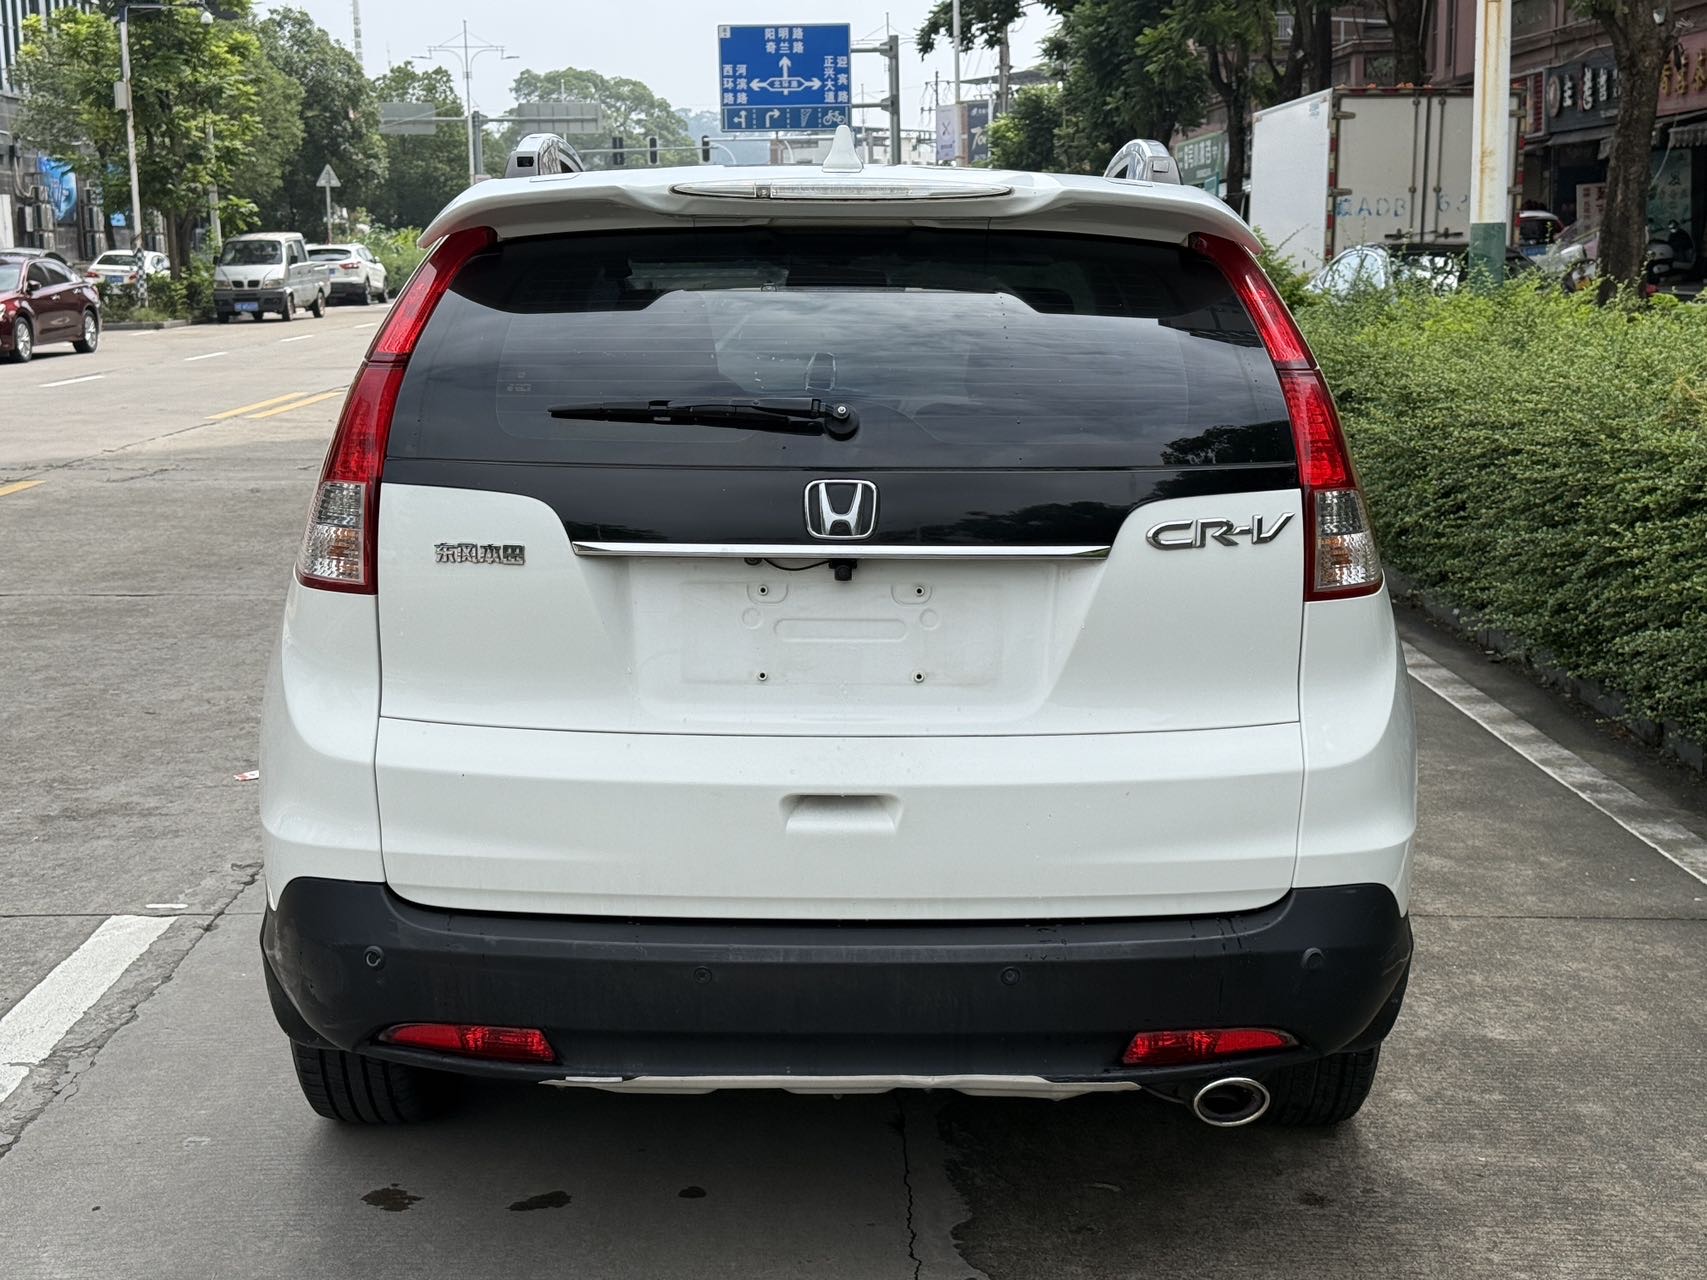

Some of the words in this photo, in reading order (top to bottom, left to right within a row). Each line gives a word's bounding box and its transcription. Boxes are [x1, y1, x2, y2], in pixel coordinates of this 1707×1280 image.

[765, 28, 804, 40] 阳明路
[765, 41, 804, 54] 奇兰路
[722, 64, 734, 104] 西环路
[736, 64, 748, 104] 河滨路
[823, 56, 836, 103] 正兴大道
[837, 56, 849, 103] 迎宾路
[1146, 512, 1296, 550] CR-V
[434, 543, 525, 565] 东风本田
